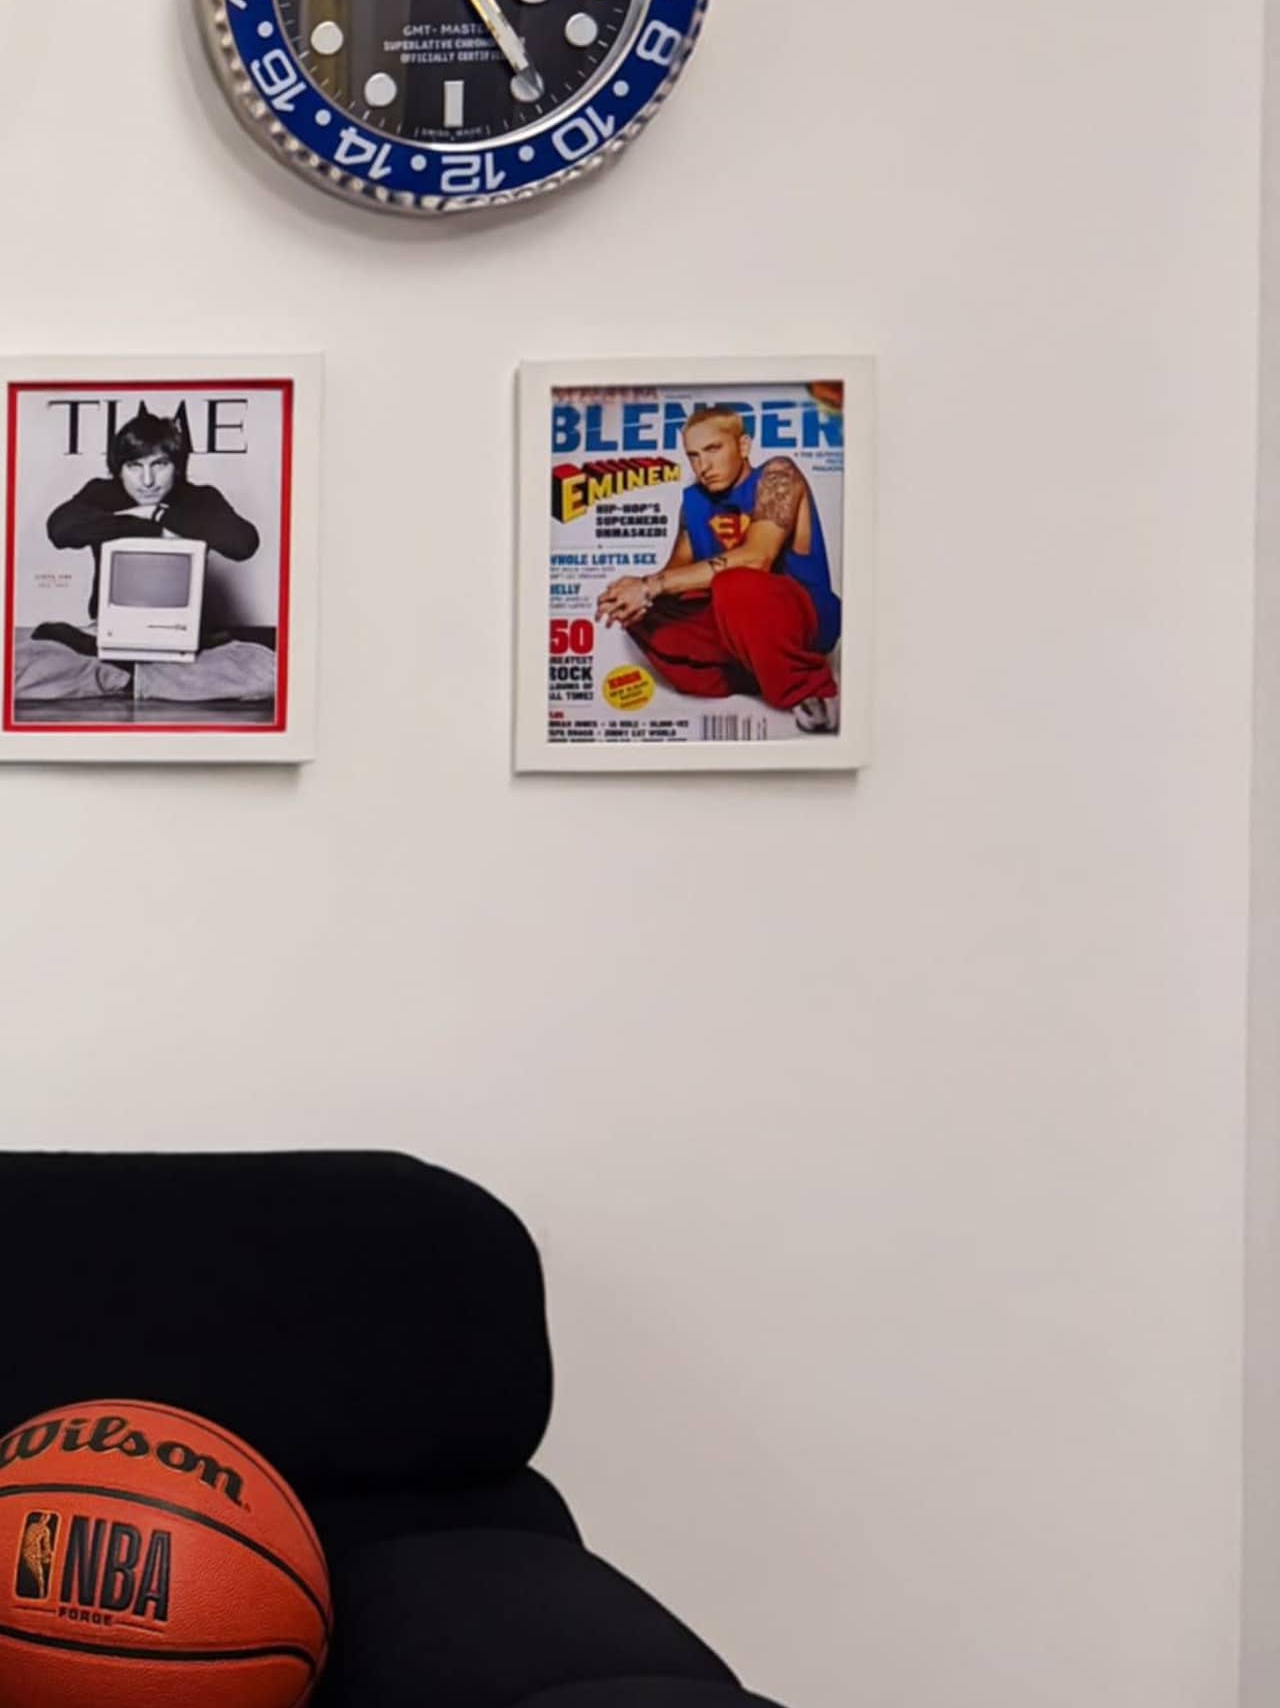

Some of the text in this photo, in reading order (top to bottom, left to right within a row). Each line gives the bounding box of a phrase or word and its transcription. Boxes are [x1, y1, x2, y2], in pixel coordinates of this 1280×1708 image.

[552, 456, 681, 524] EMINEM
[596, 516, 668, 526] SUPERHERO
[592, 554, 630, 564] LOTTA
[633, 553, 656, 564] SEX
[550, 619, 594, 655] 50
[59, 1514, 173, 1622] NBA
[58, 1606, 113, 1626] FORGE
